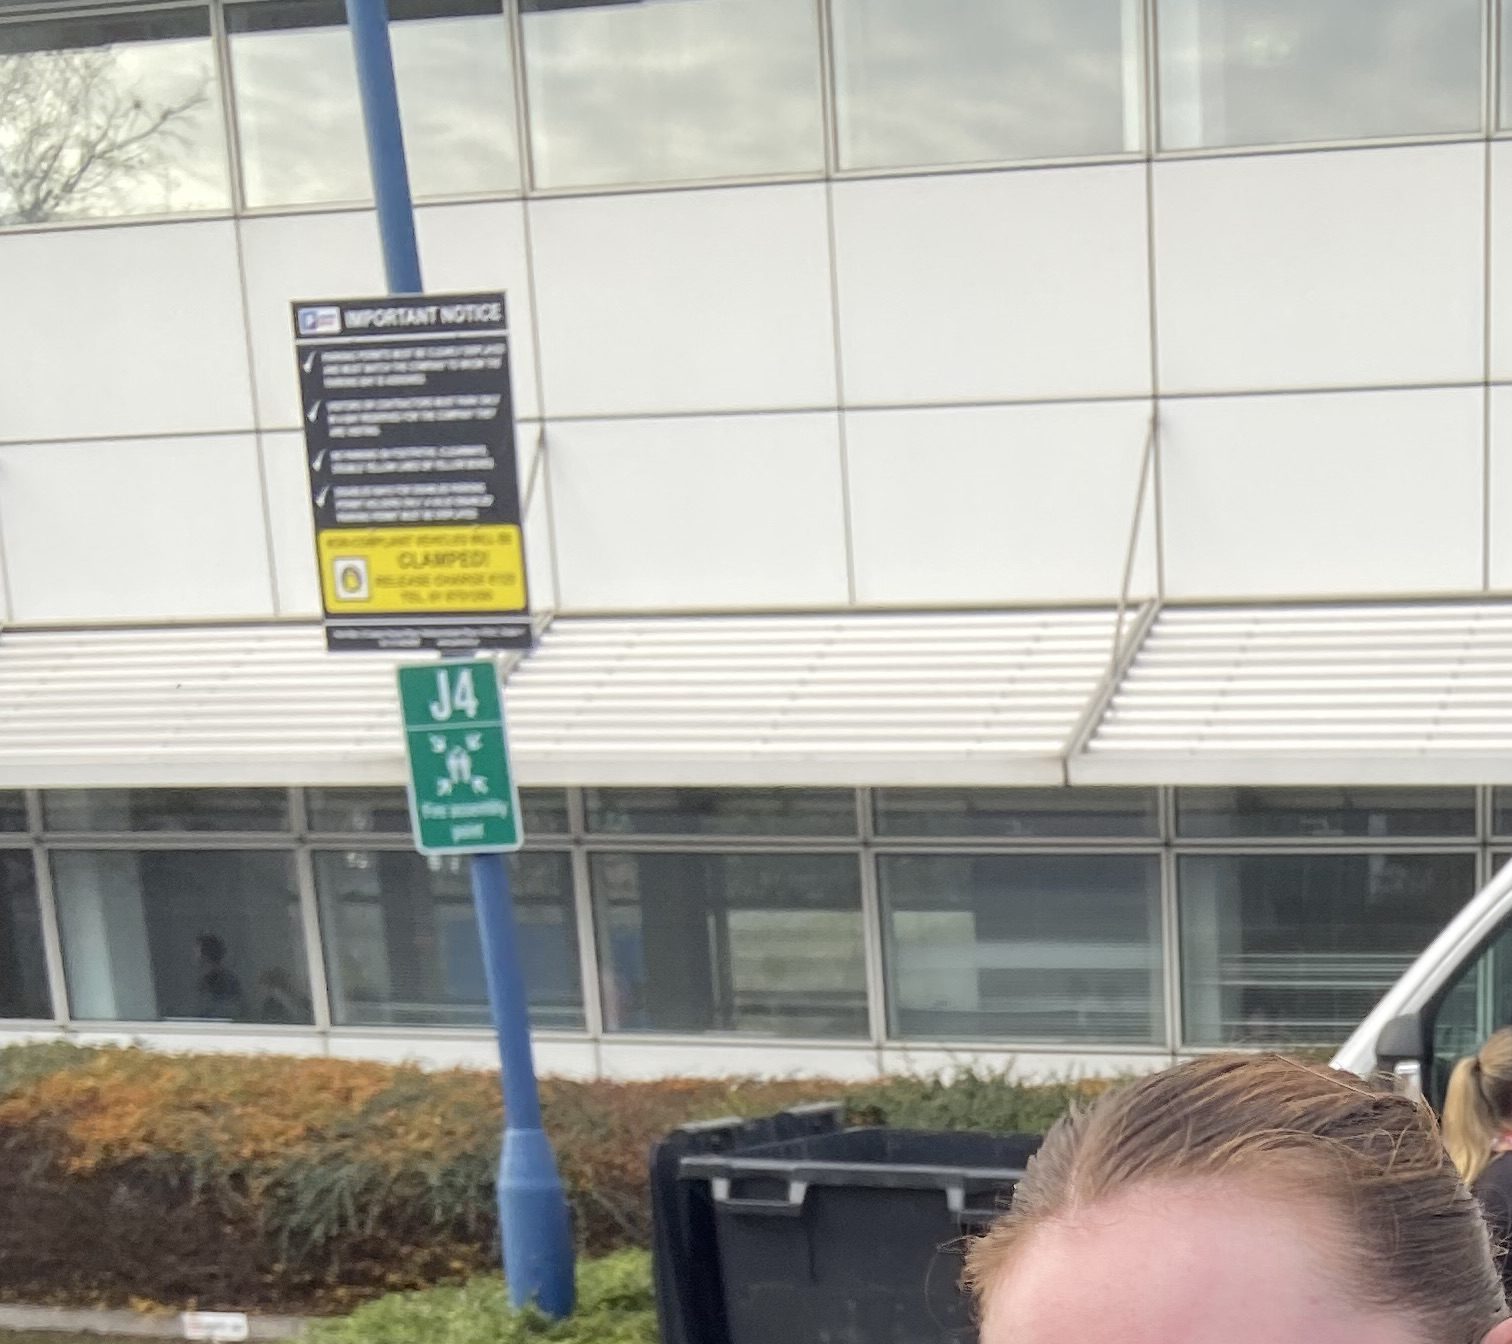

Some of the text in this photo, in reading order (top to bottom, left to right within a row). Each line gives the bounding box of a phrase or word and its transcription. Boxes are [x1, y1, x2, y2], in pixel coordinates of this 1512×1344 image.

[344, 305, 439, 328] IMPORTANT
[440, 302, 503, 324] NOTICE
[429, 668, 479, 721] J4
